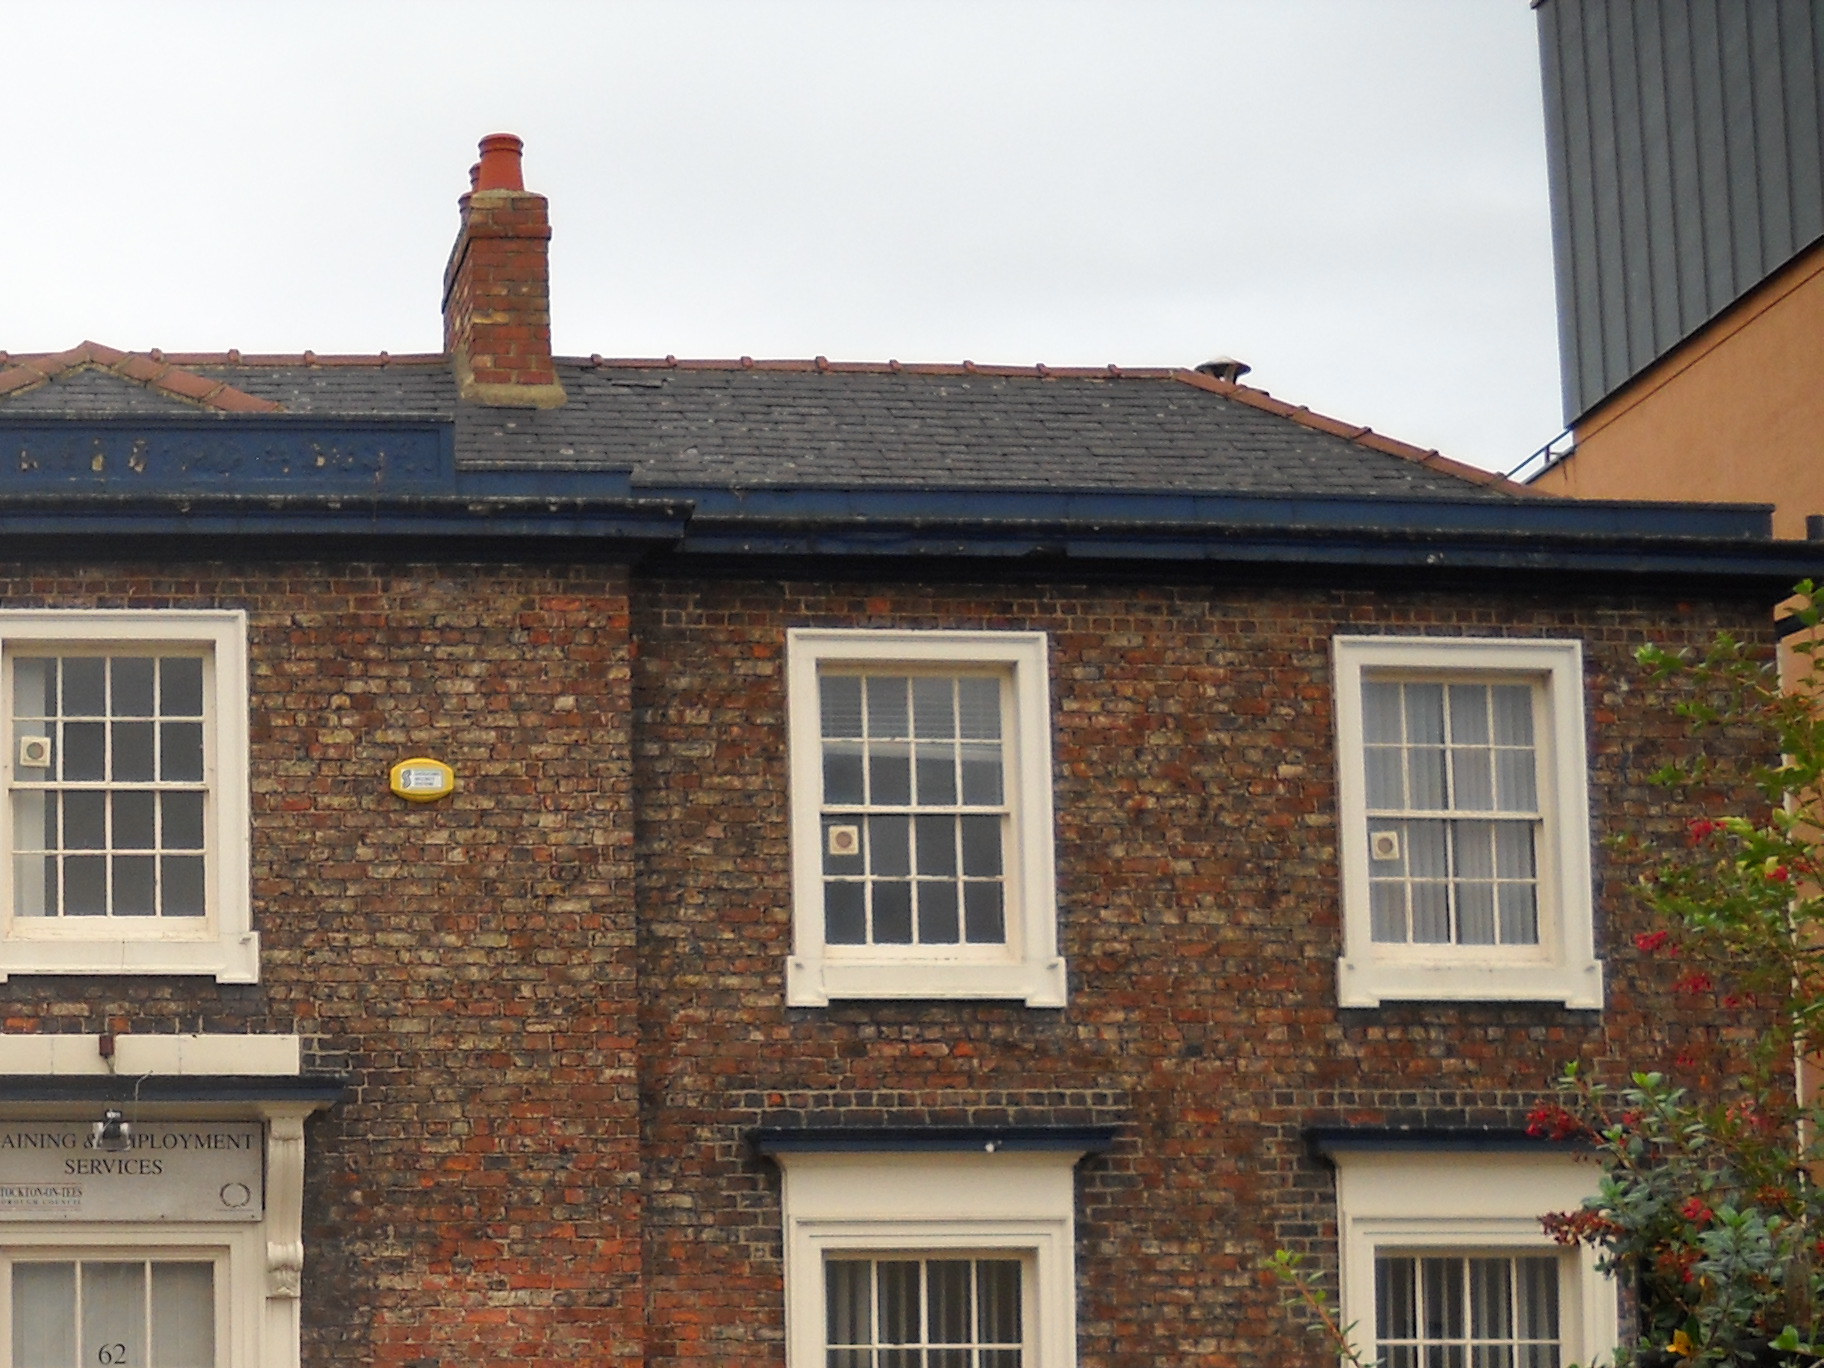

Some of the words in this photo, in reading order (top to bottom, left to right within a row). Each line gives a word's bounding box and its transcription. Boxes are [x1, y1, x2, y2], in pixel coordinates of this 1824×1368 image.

[106, 1133, 254, 1149] PLOYMENT
[64, 1158, 163, 1175] SERVICES
[98, 1343, 126, 1365] 62
